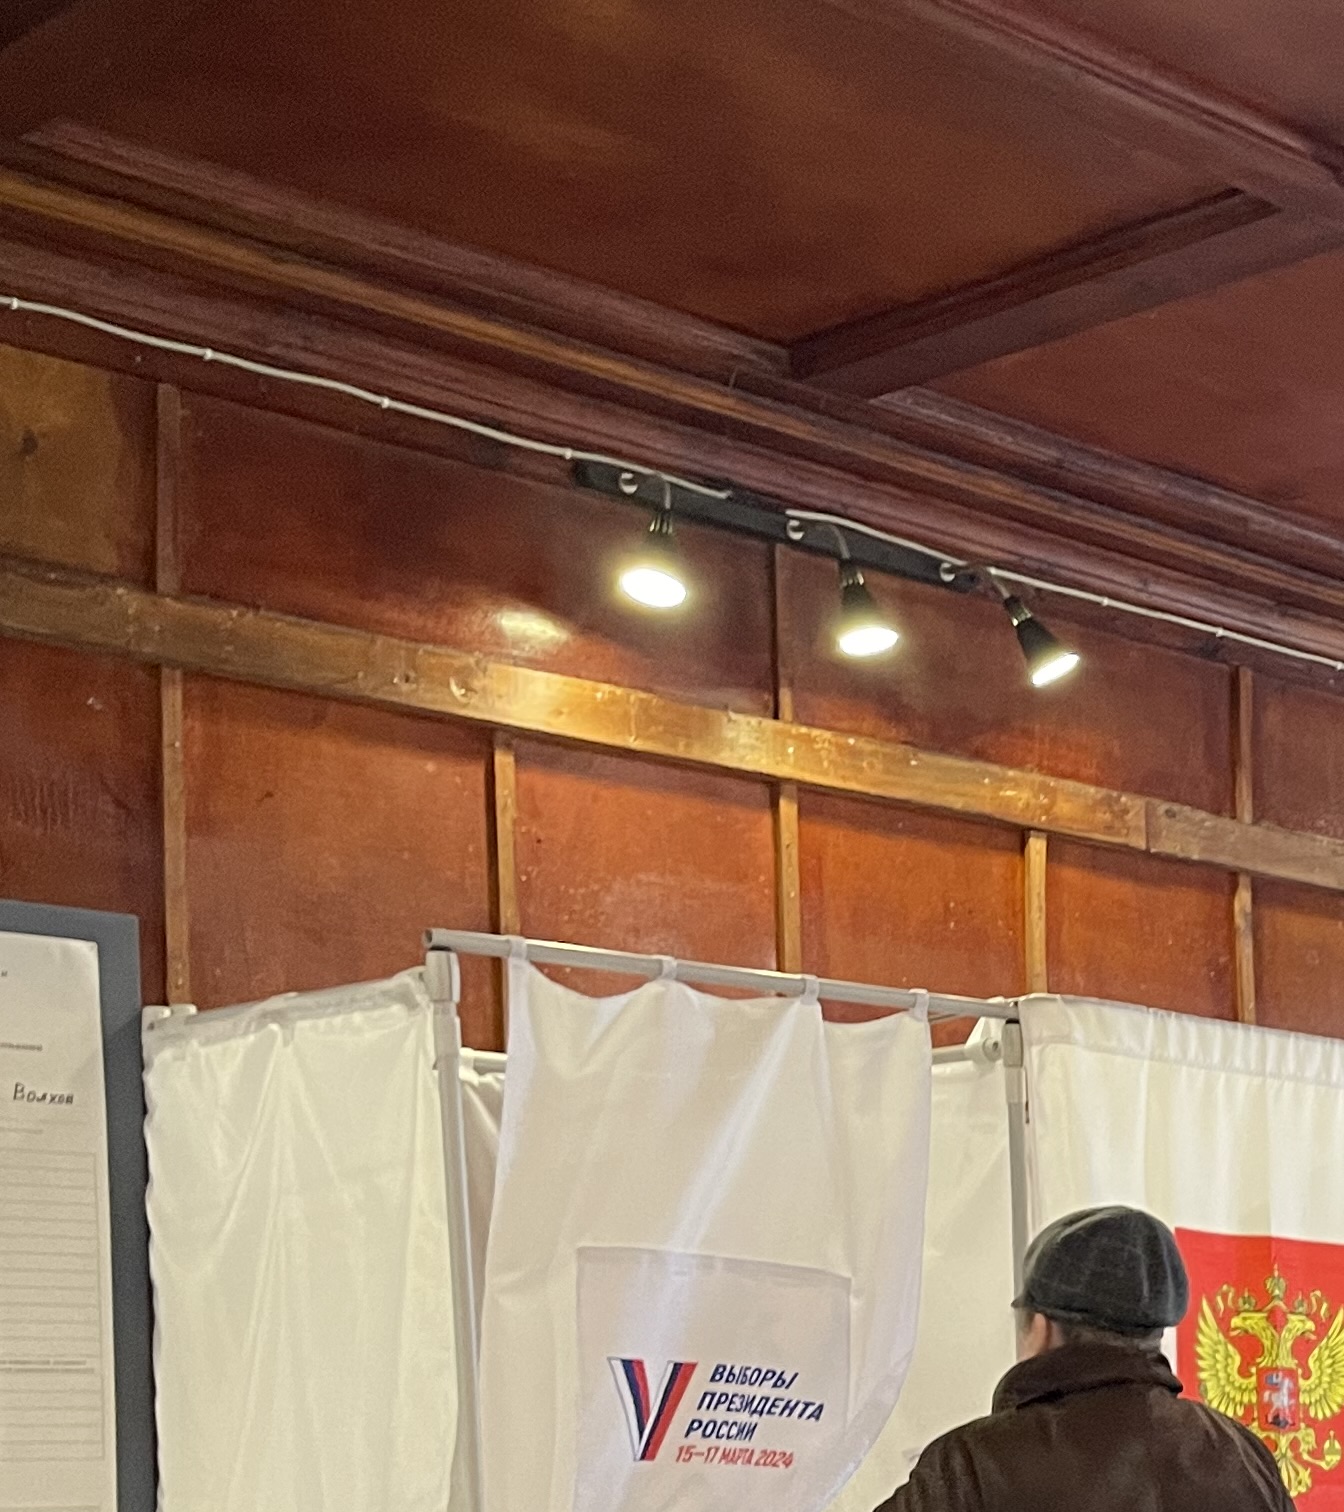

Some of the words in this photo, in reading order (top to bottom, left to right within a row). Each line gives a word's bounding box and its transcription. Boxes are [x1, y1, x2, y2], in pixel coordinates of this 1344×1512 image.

[709, 1363, 799, 1390] ВЫБОРЫ
[697, 1391, 825, 1422] ПРЕЗИДЕНТА
[684, 1418, 758, 1441] РОССИИ
[717, 1446, 755, 1466] МАРТА
[754, 1449, 794, 1469] 2024
